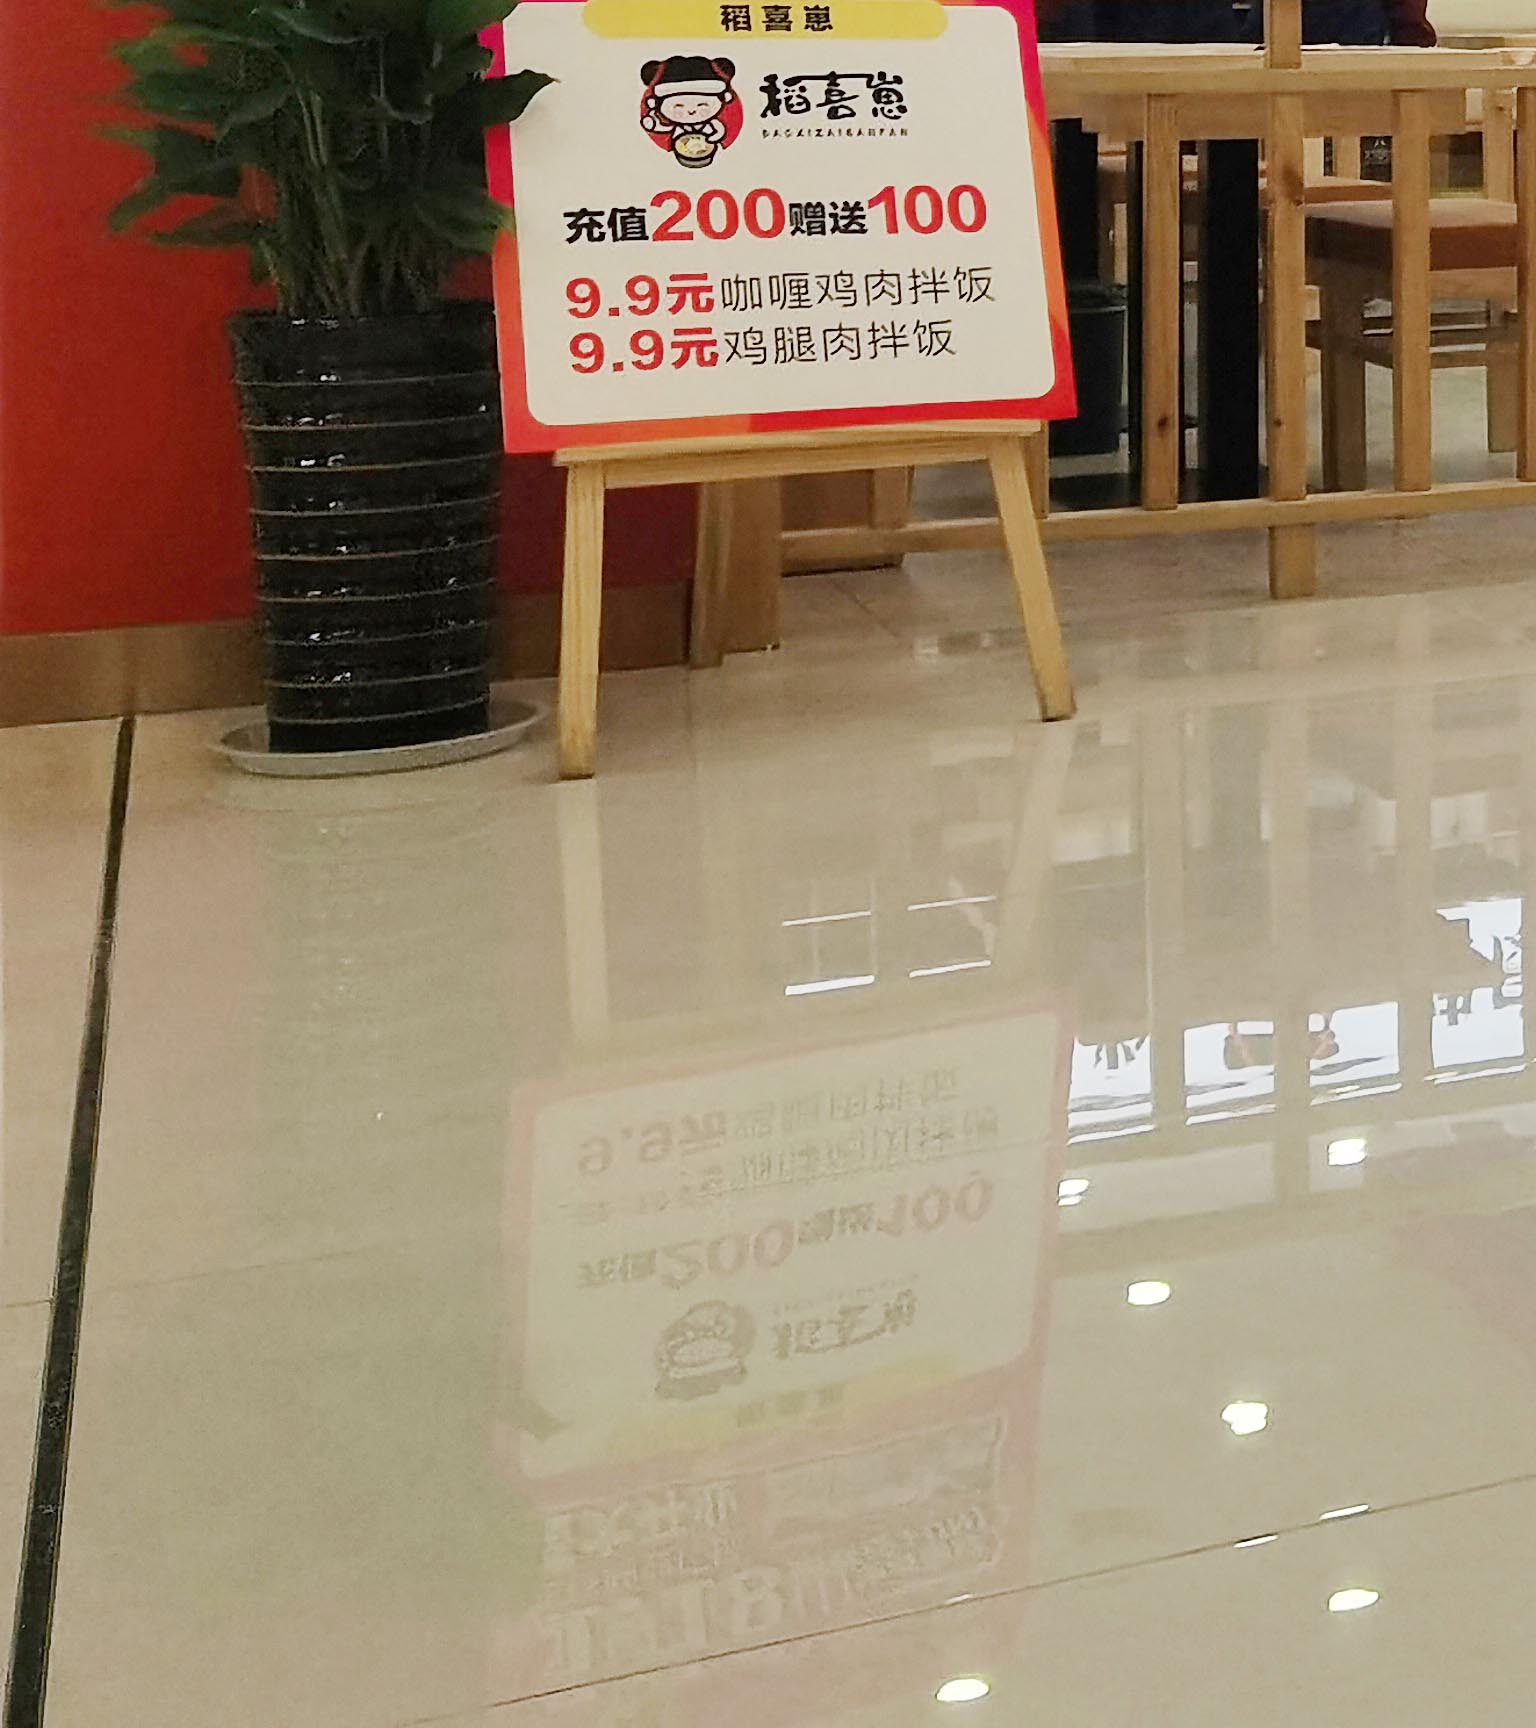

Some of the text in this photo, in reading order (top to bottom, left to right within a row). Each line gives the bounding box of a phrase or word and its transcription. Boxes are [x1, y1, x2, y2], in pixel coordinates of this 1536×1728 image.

[719, 3, 834, 33] 稻喜崽
[562, 183, 988, 245] 充值200赠送100
[565, 265, 997, 320] 9.9元咖喱鸡肉拌饭
[568, 318, 958, 374] 9.9元鸡腿肉拌饭
